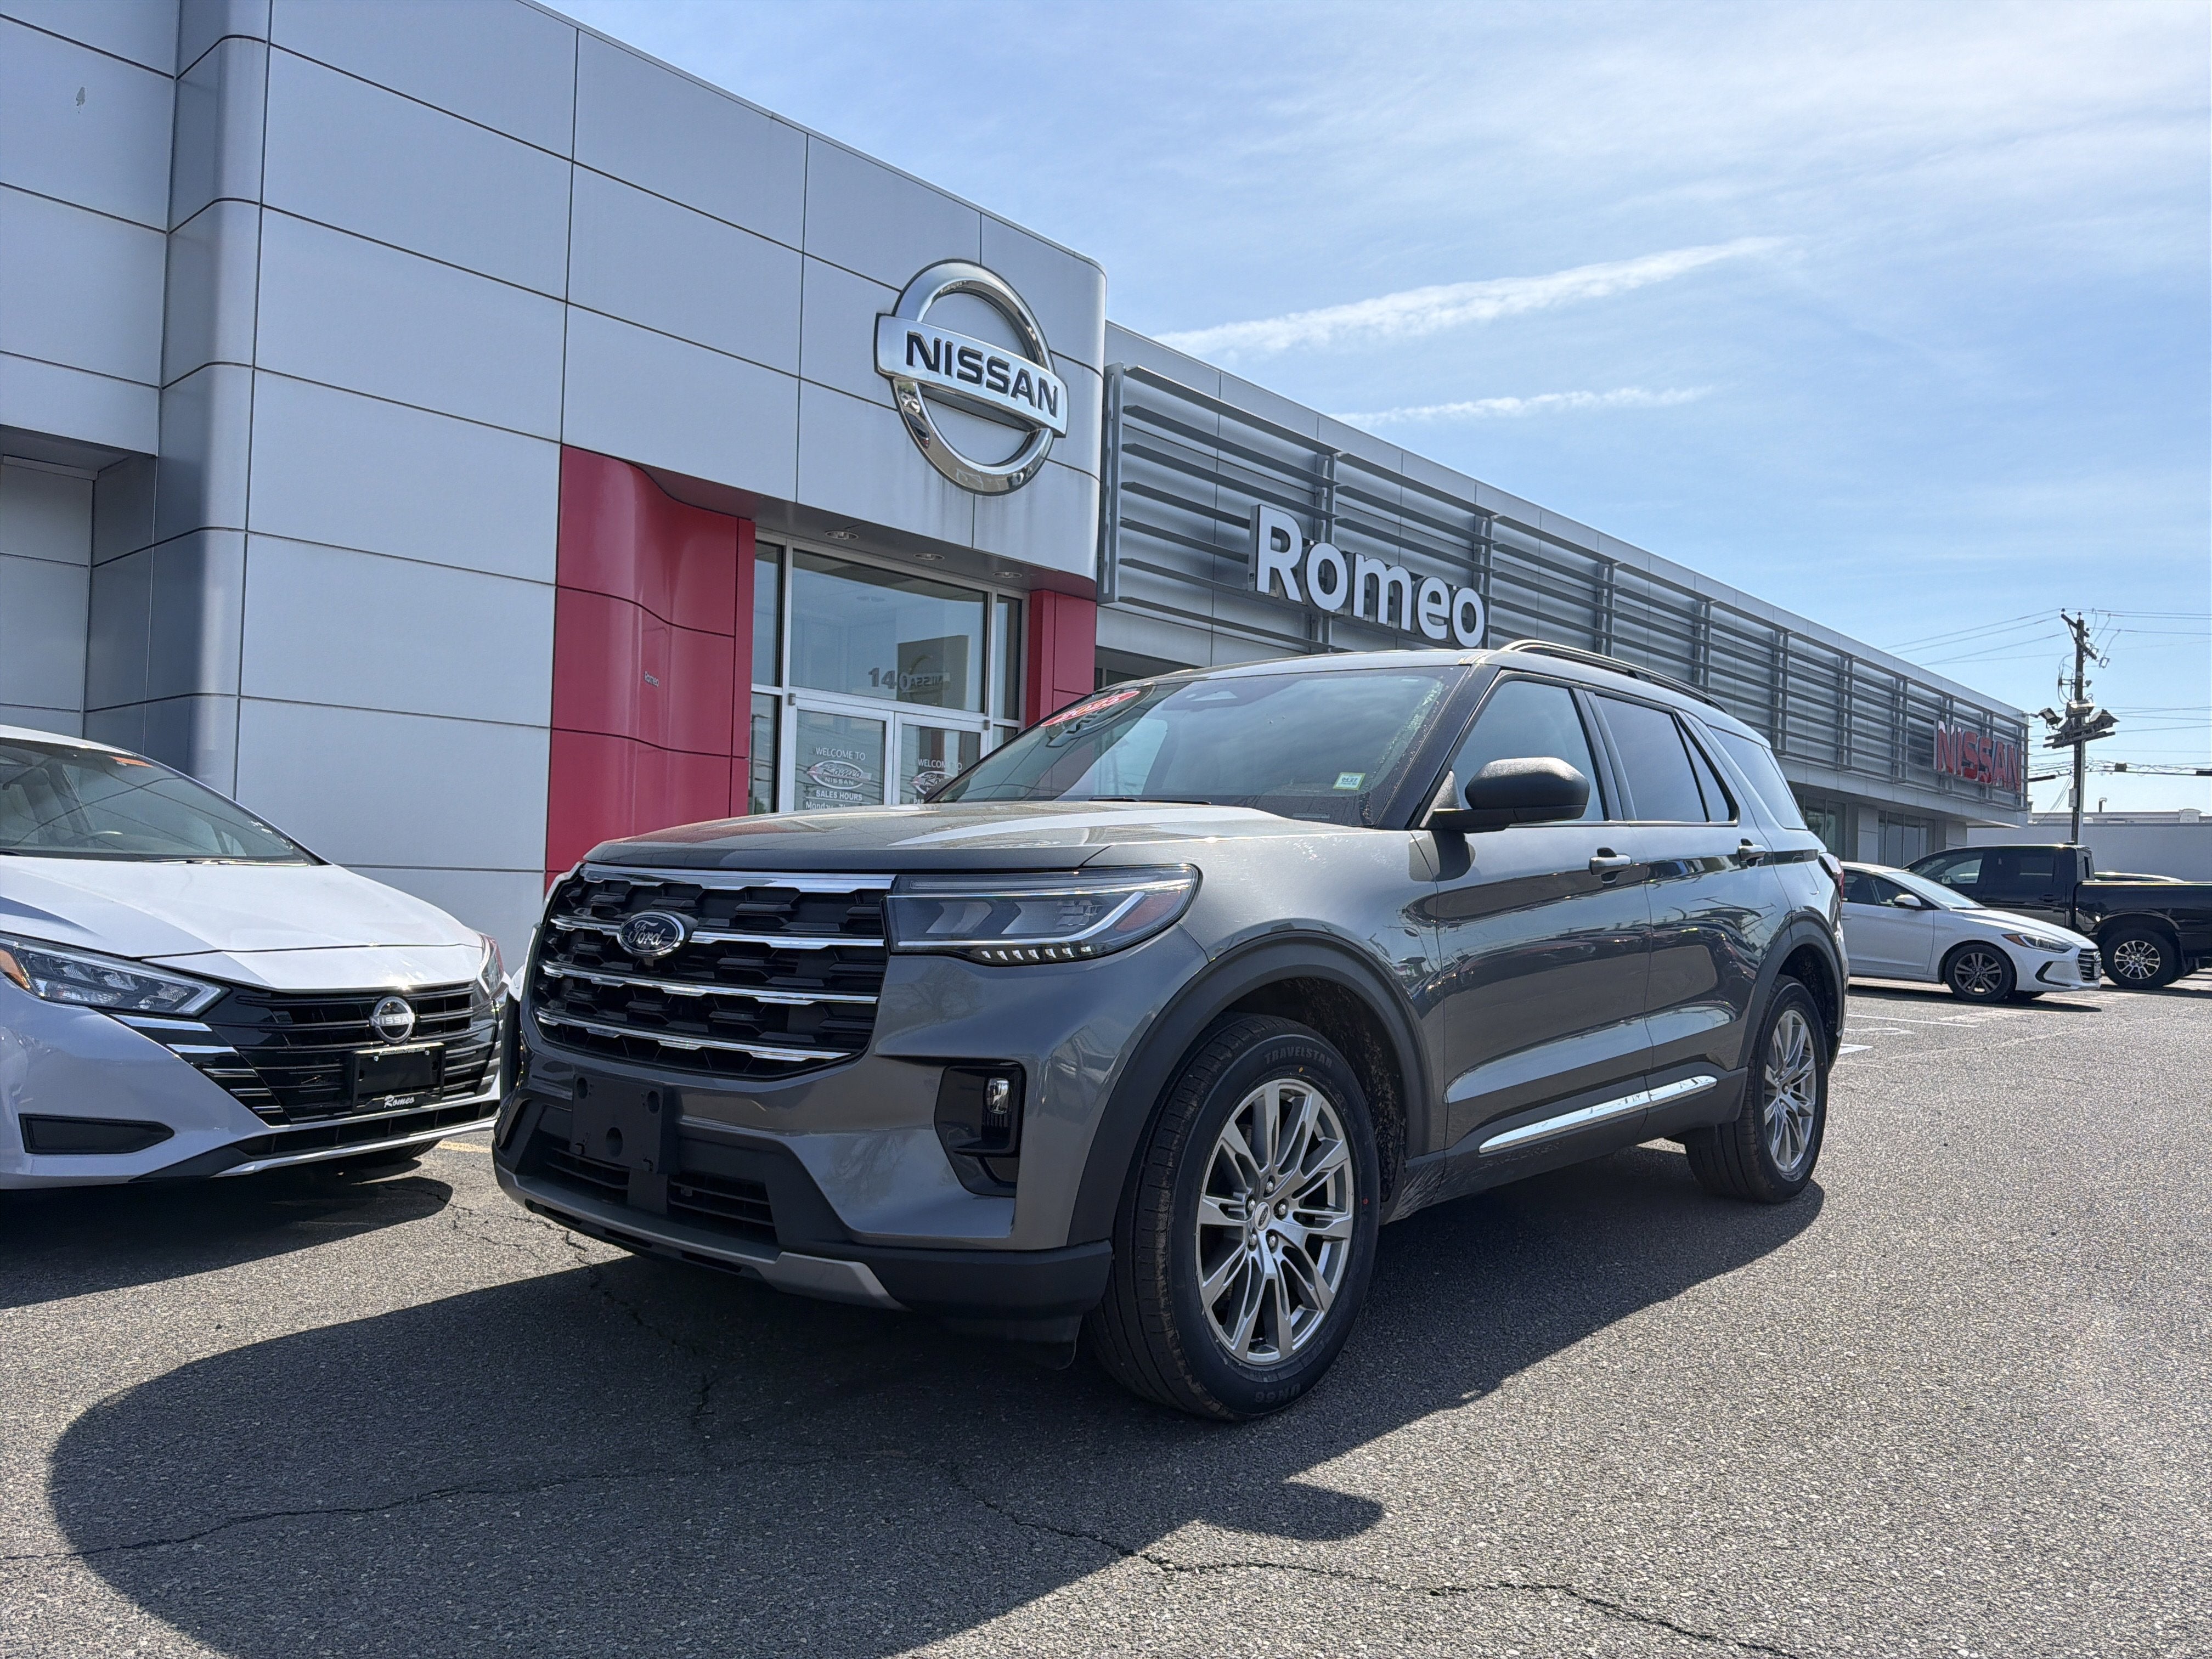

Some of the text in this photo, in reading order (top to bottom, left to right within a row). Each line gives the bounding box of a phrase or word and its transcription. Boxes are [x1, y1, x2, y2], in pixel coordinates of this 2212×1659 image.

[906, 330, 1058, 419] NISSAN
[1254, 504, 1485, 648] Romeo
[868, 667, 912, 692] 140
[816, 746, 866, 761] WELCOME TO
[1937, 720, 2022, 793] NISSAN
[822, 762, 862, 778] Romeo
[825, 777, 854, 786] NISSAN
[816, 789, 862, 802] SALES HOURS
[628, 919, 666, 946] Ford
[371, 1014, 413, 1025] NISSAN
[1264, 1046, 1333, 1069] TRAVELSTAR
[383, 1094, 415, 1108] Romeo
